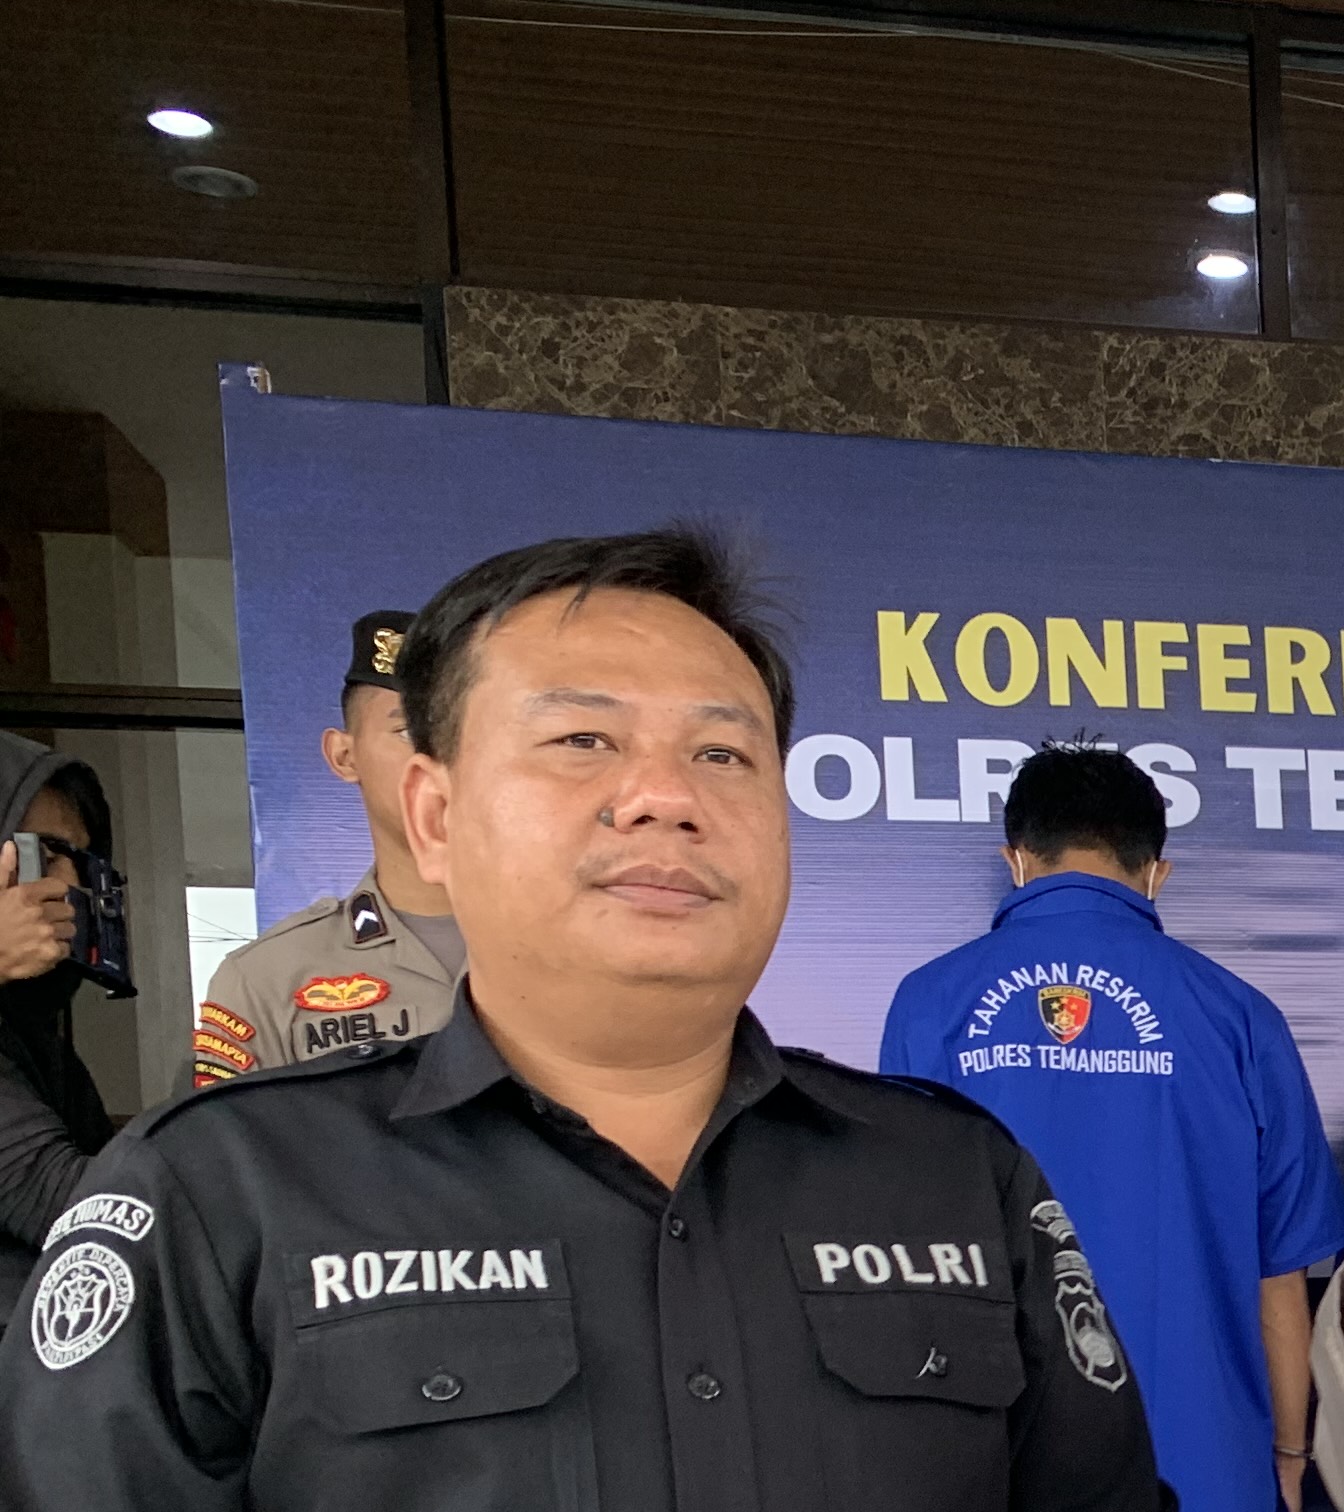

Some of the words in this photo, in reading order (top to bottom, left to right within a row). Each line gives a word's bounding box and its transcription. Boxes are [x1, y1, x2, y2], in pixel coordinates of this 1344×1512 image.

[785, 734, 1201, 829] OLRS
[968, 962, 1069, 1039] TAHANAN
[1075, 964, 1164, 1044] RESKRIM
[305, 1012, 386, 1053] ARIEL
[393, 1009, 410, 1036] J
[958, 1044, 1032, 1076] POLRES
[1036, 1045, 1174, 1075] TEMANGGUNG
[74, 1200, 146, 1232] HUMAS
[311, 1248, 549, 1309] ROZIKAN
[813, 1242, 989, 1287] POLRI
